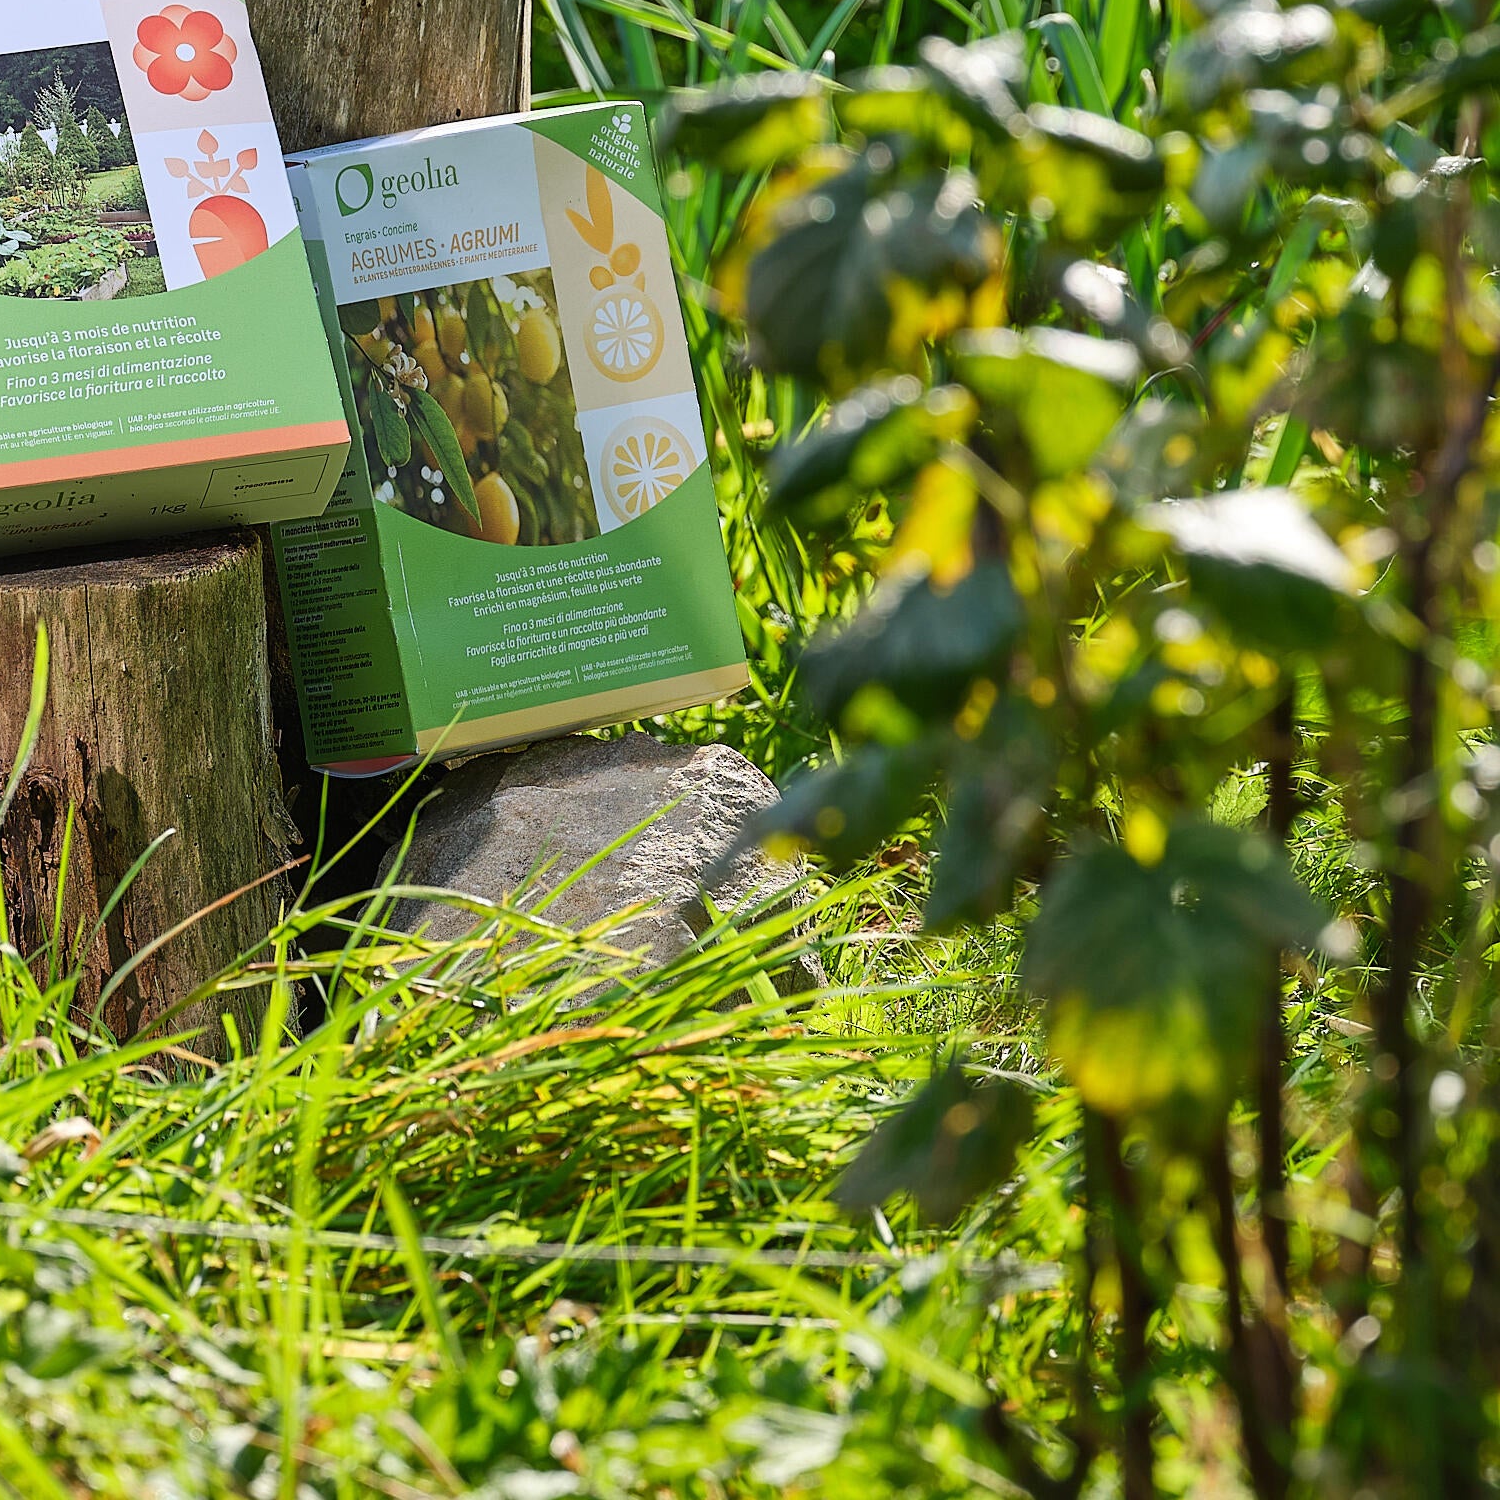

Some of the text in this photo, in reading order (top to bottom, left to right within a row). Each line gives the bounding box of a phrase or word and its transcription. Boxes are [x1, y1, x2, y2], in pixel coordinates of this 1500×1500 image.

[591, 134, 640, 168] naturelle
[601, 125, 639, 153] origine
[588, 147, 634, 179] naturale
[381, 157, 458, 208] geolia
[344, 222, 417, 243] Engrais Concime
[352, 222, 518, 271] AGRUMES AGRUMI
[4, 315, 196, 349] Jusqu'à 3 mois de nutrition
[51, 348, 65, 360] la
[68, 341, 131, 357] floraison
[135, 337, 150, 349] et
[152, 335, 166, 346] la
[170, 329, 220, 344] récolte
[0, 368, 225, 407] Favorisce la fioritura e il raccolto
[7, 354, 211, 389] Fino a 3 mesi di alimentazione
[473, 574, 641, 616] Enrichi en magnésium, feuille plus verte
[491, 624, 648, 667] Foglie arricchite di magnesio e più verdi
